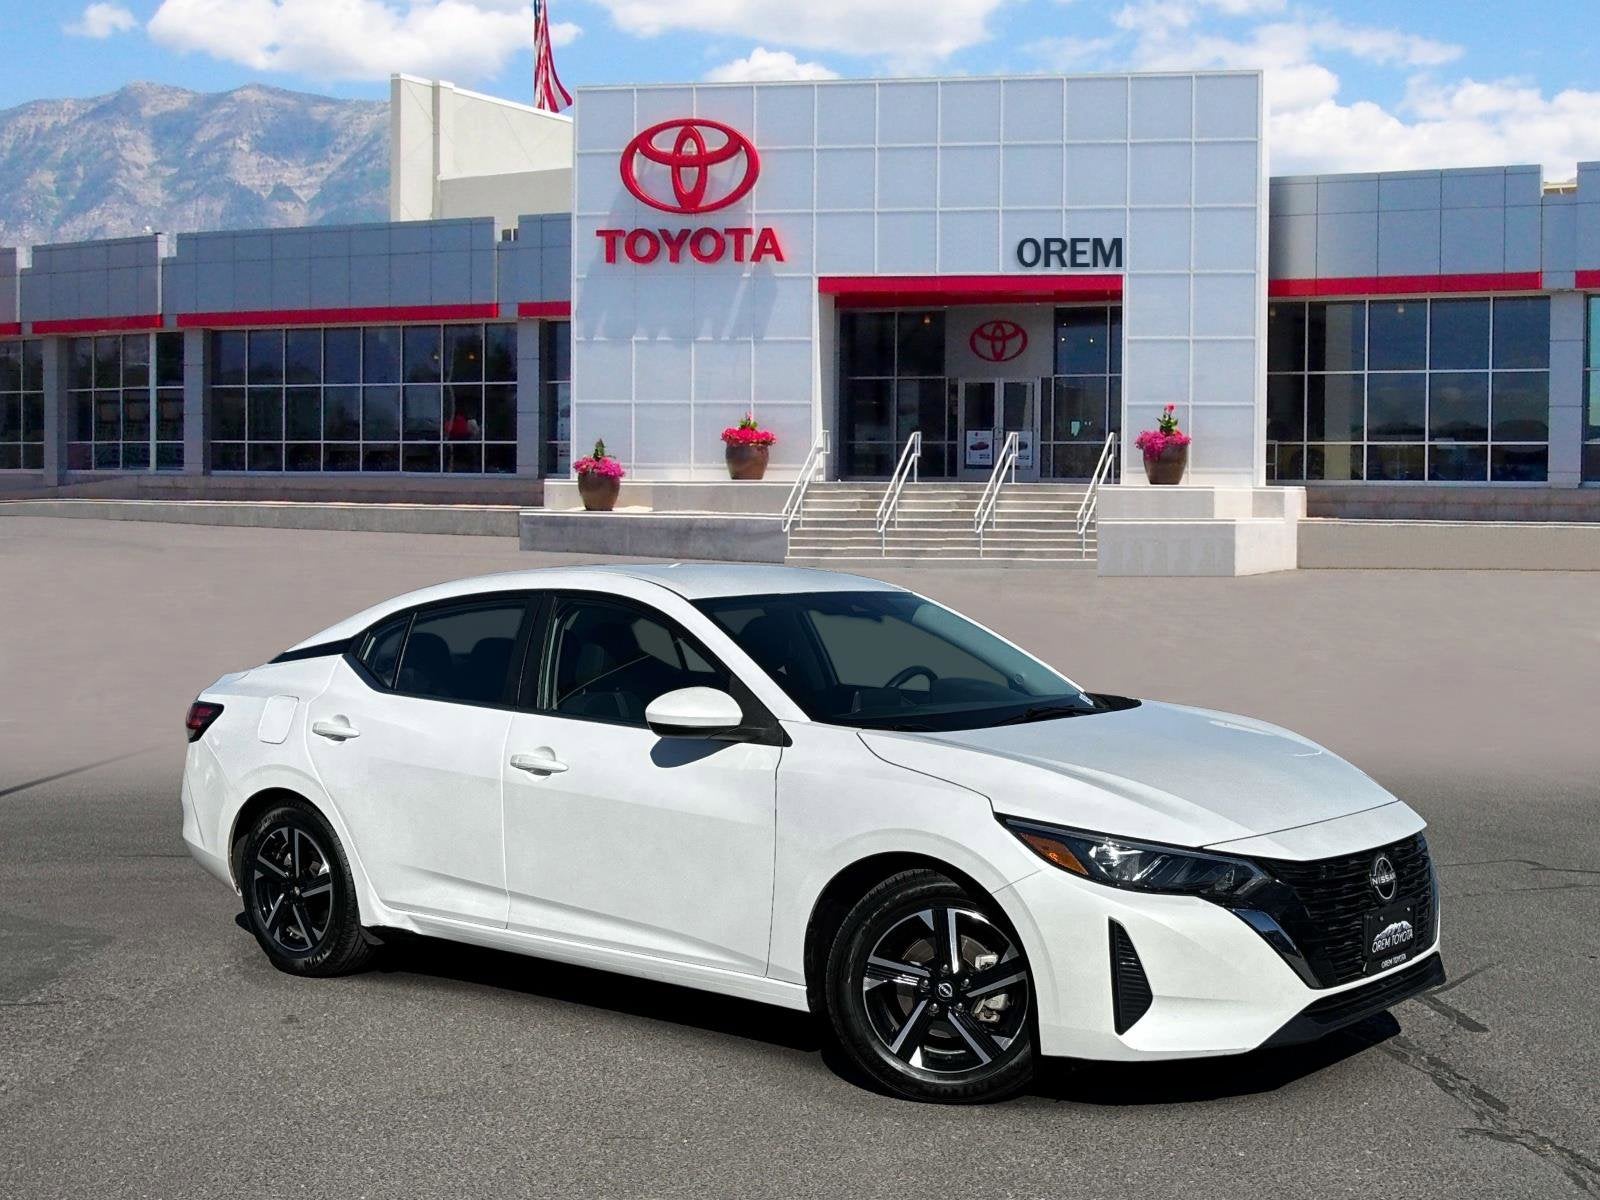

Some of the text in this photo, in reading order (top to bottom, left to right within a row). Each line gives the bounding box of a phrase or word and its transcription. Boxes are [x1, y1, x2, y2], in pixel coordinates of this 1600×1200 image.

[596, 227, 784, 264] TOYOTA
[1017, 238, 1122, 267] OREM
[1372, 927, 1413, 953] OREM TOYOTA
